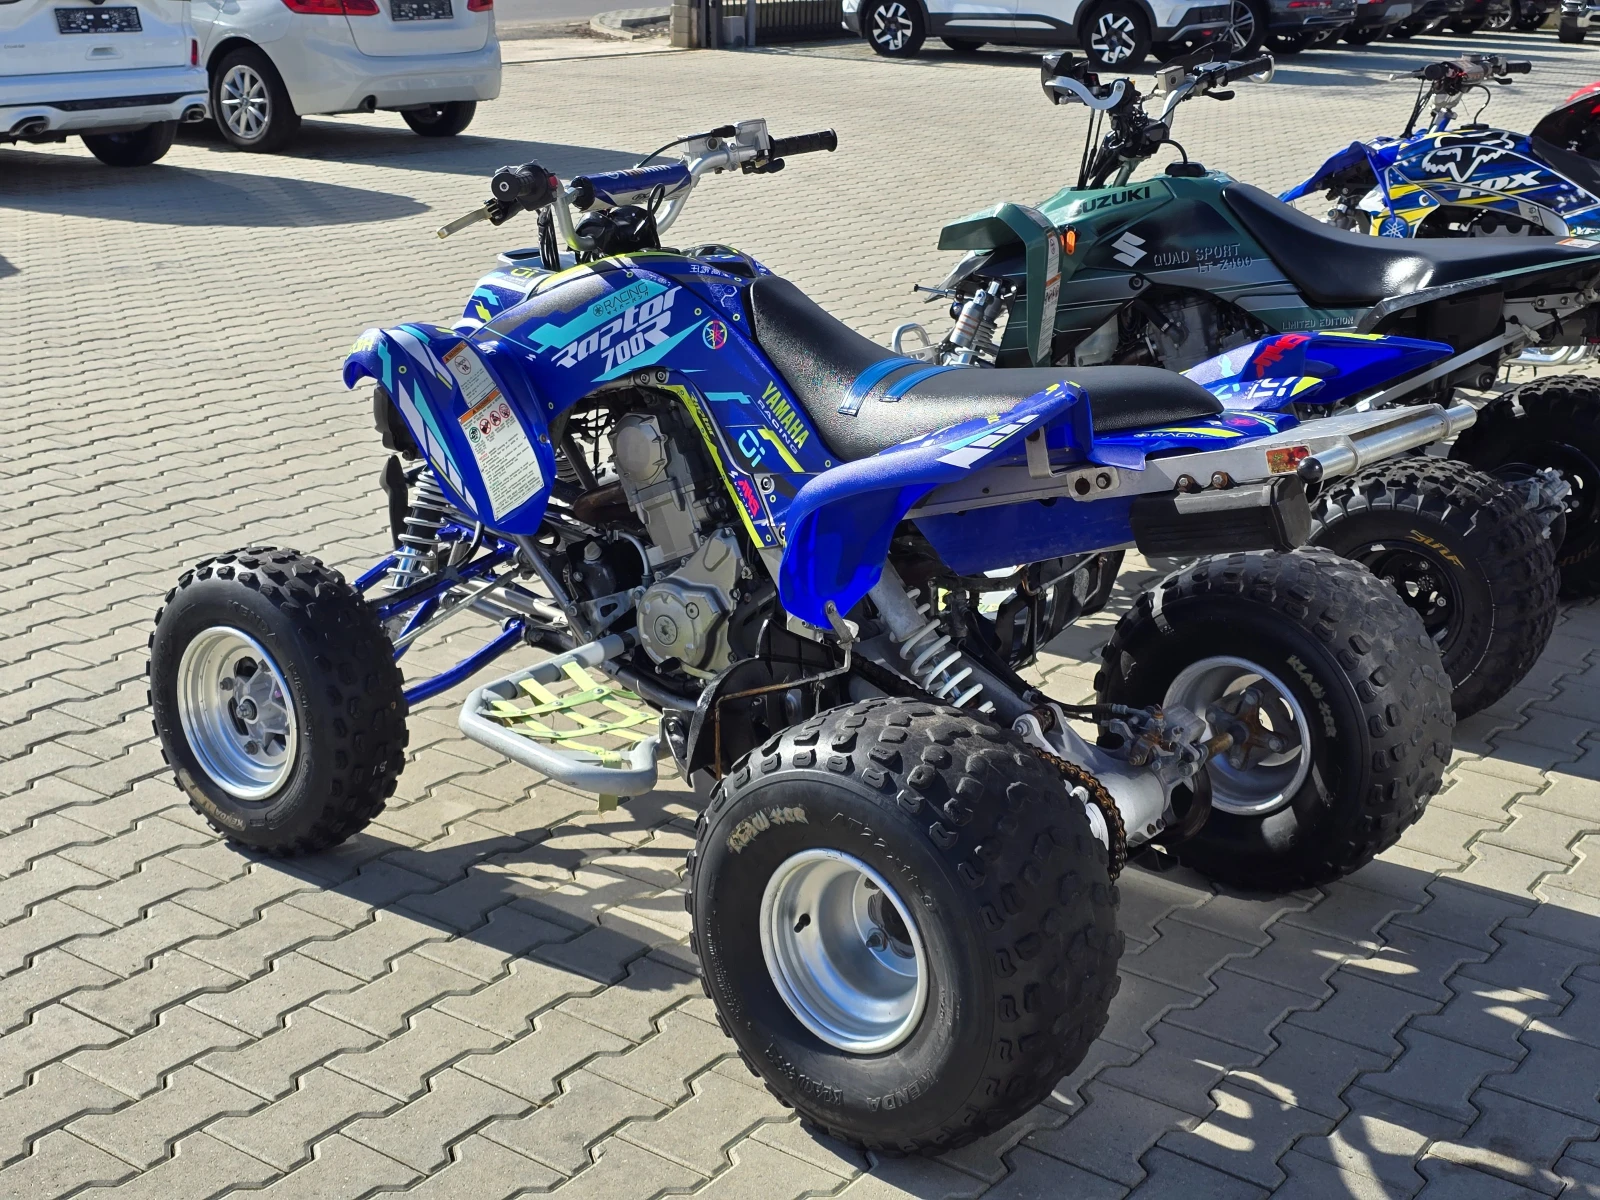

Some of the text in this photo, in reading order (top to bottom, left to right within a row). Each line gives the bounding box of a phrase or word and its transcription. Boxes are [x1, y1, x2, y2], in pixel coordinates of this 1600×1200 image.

[1458, 170, 1543, 198] FOX
[1154, 243, 1241, 267] QUAD SPORT
[603, 281, 649, 312] RACING
[1282, 316, 1354, 330] LIMITED EDITION
[757, 399, 799, 455] RACING
[761, 381, 810, 449] YAMAHA
[866, 1069, 939, 1112] KENDA
